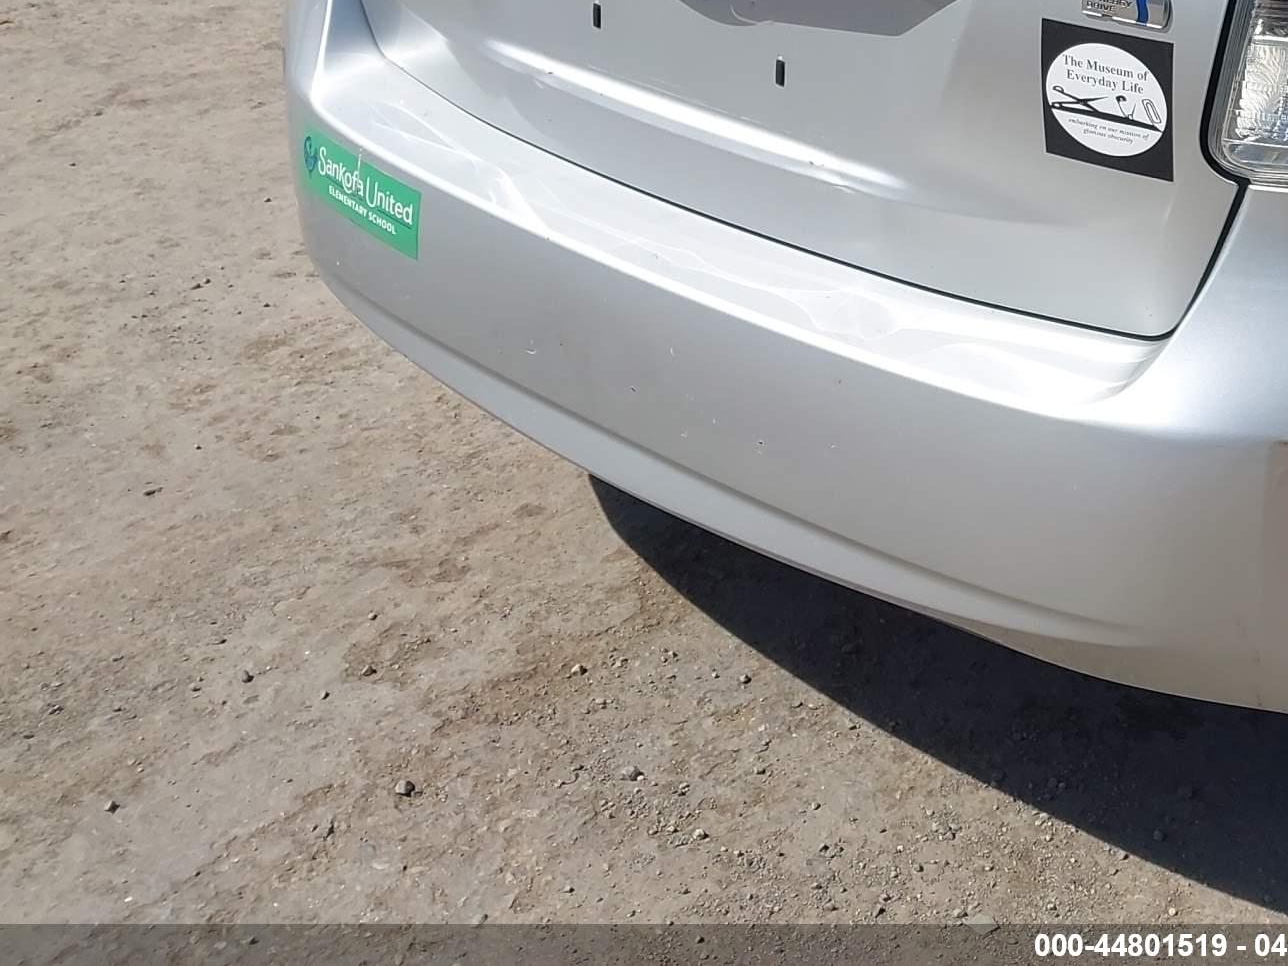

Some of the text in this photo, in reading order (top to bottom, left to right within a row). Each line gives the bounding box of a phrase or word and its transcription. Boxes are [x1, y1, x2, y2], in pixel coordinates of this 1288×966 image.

[1063, 54, 1150, 81] The Museum of
[1066, 68, 1144, 95] Everyday Life
[318, 146, 413, 225] Sankofa United
[328, 185, 397, 235] ELEMENTARY SCHOOL
